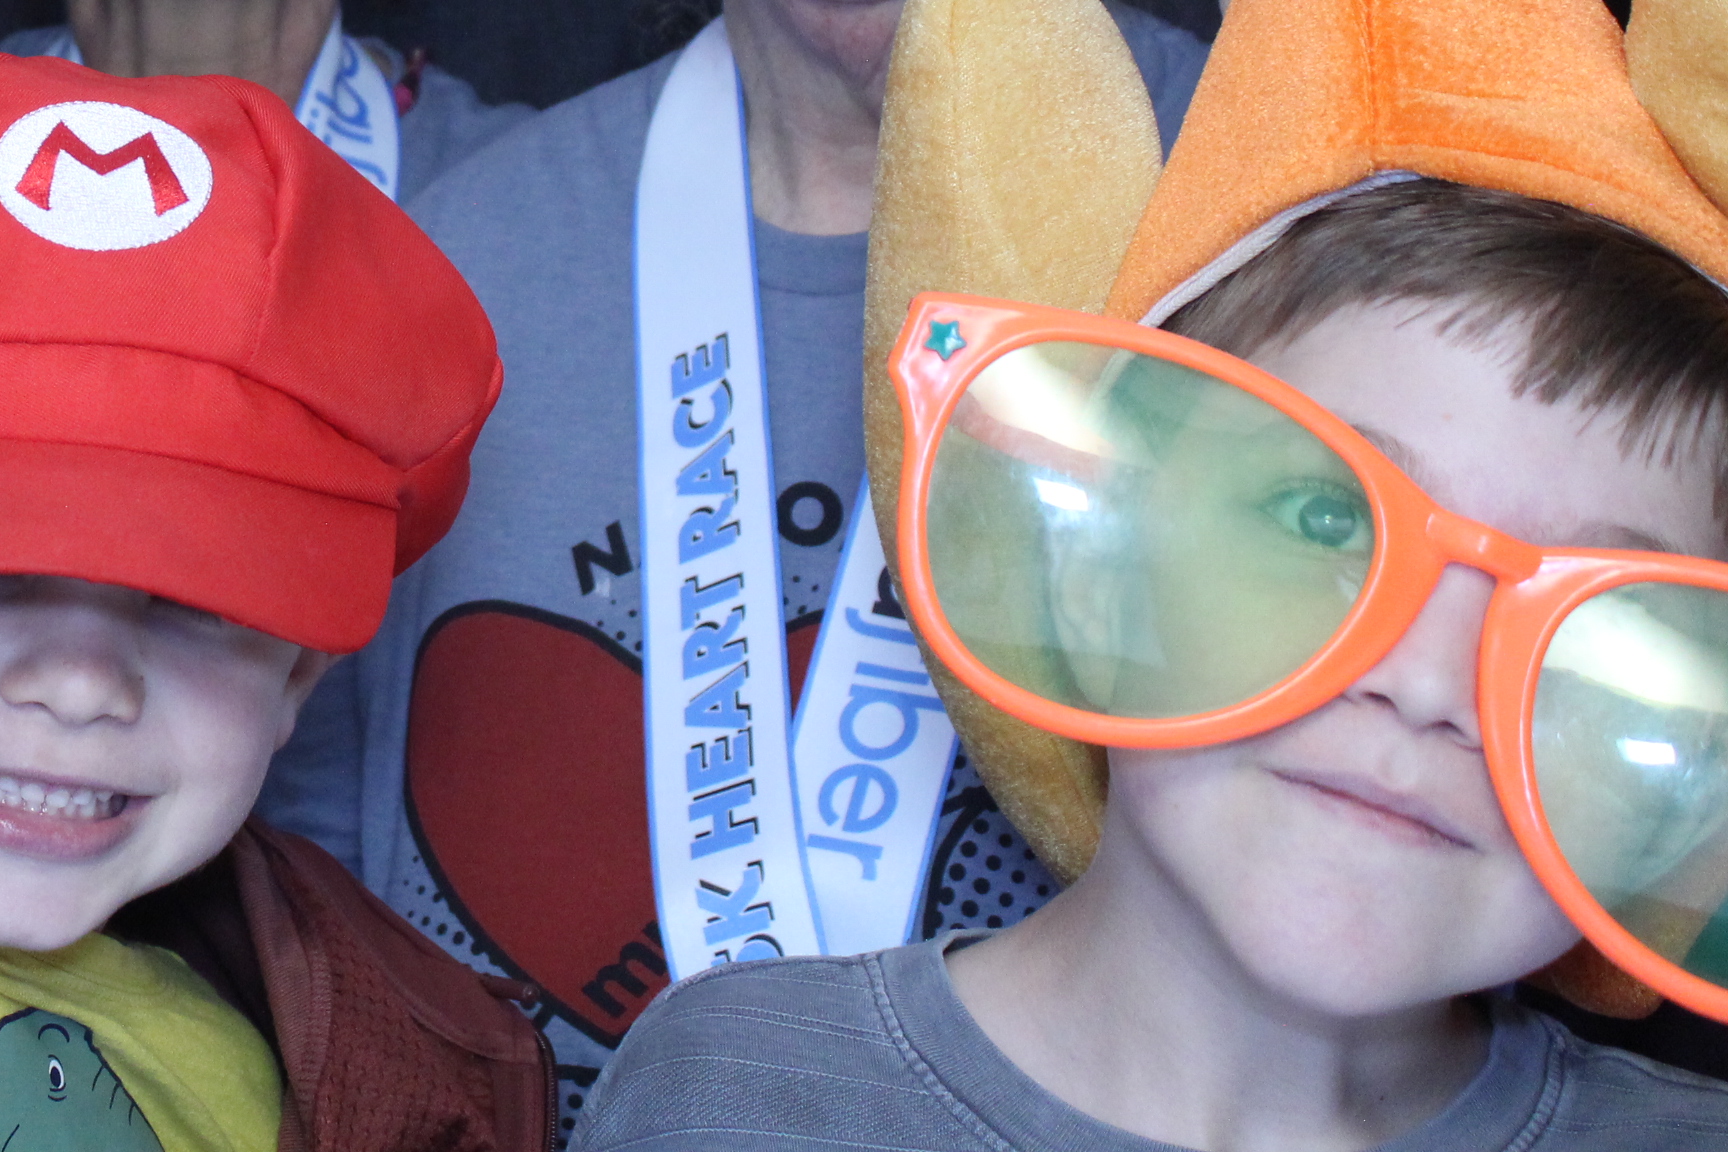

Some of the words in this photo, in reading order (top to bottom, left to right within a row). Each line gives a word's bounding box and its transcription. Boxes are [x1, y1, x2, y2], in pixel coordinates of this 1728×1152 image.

[15, 120, 189, 217] M
[671, 332, 742, 565] RACE
[677, 570, 760, 860] HEART
